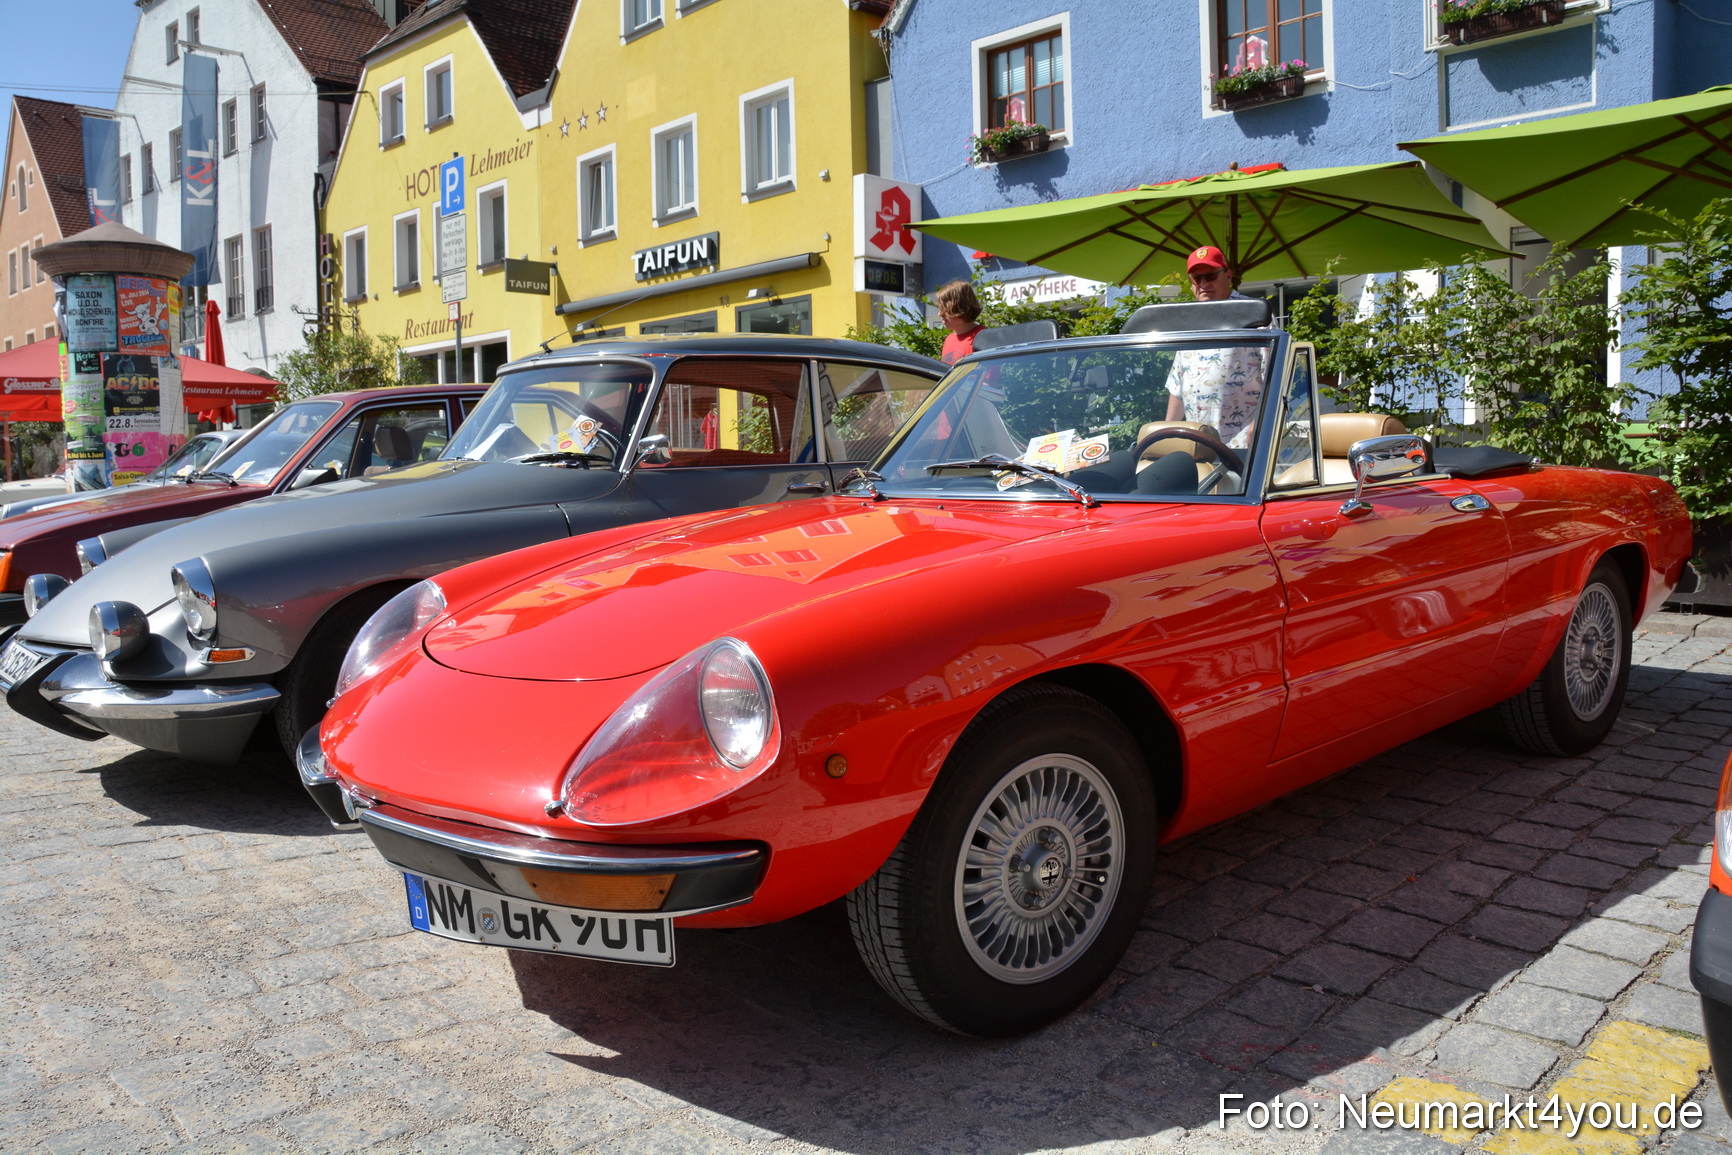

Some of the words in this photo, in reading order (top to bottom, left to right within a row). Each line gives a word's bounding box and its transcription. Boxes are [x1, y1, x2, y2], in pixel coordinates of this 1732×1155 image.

[186, 139, 214, 206] K&L
[406, 162, 443, 201] HOT
[469, 138, 533, 177] Lehmeier
[446, 166, 459, 209] P
[631, 237, 708, 274] TAIFUN
[509, 279, 548, 291] TAIFUN
[1010, 279, 1077, 300] APOTHEKE
[75, 291, 102, 299] SAXON
[78, 300, 101, 308] U.D.O.
[225, 387, 262, 396] Lehmeier
[109, 418, 133, 429] 22.8.
[114, 442, 145, 457] G6
[415, 906, 423, 919] D
[424, 880, 476, 934] NM
[500, 900, 562, 943] GK
